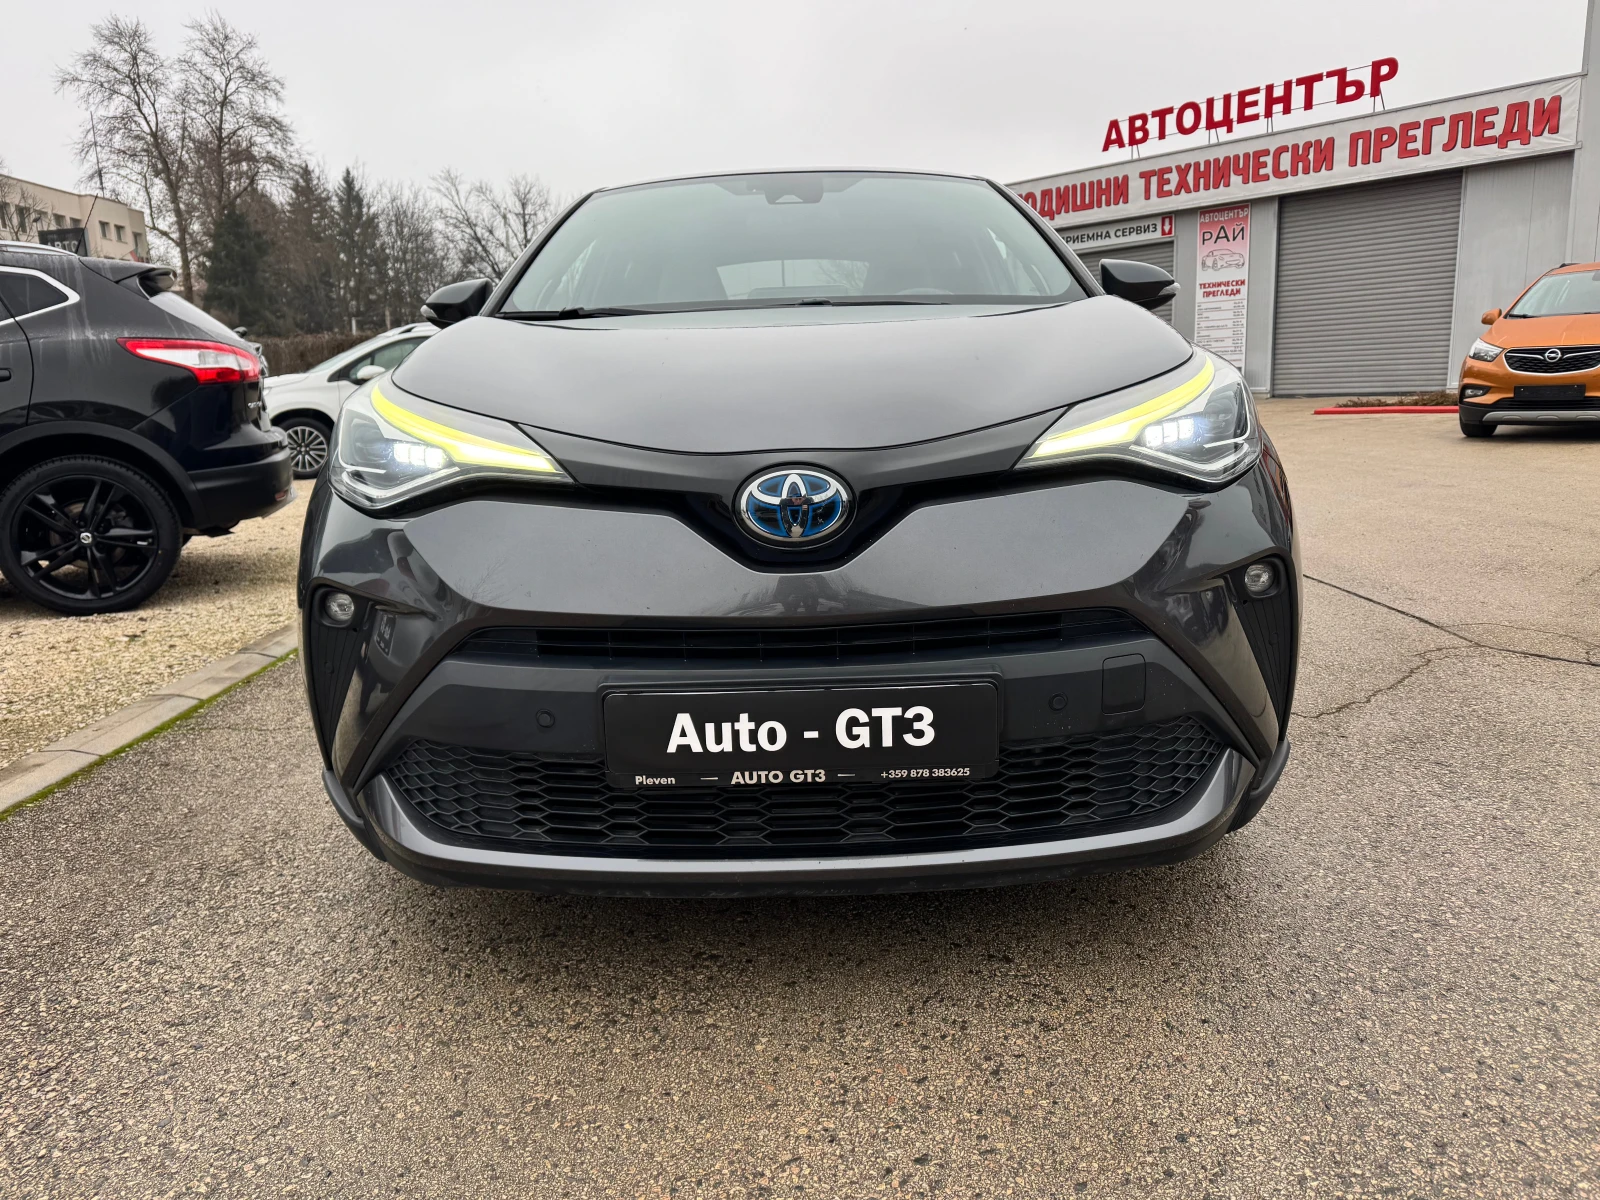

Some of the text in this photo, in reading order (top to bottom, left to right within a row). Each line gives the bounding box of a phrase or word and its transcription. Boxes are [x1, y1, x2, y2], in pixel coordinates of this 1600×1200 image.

[1101, 57, 1399, 152] АВТОЦЕНТЪР
[1017, 95, 1562, 220] ОДИШНИ ТЕХНИЧЕСКИ ПРЕГЛЕДИ
[1200, 207, 1249, 223] АВТОЦЕНТЪР
[1114, 223, 1158, 238] СЕРВИЗ
[1202, 223, 1245, 245] РАЙ
[1199, 279, 1246, 290] ТЕХНИЧЕСКИ
[1202, 288, 1241, 298] ПРЕГЛЕДИ
[666, 712, 787, 753] Auto
[835, 706, 935, 749] GT3
[635, 775, 676, 785] Pleven
[731, 769, 826, 785] AUTO GT3
[880, 767, 970, 779] +359 878 383625
